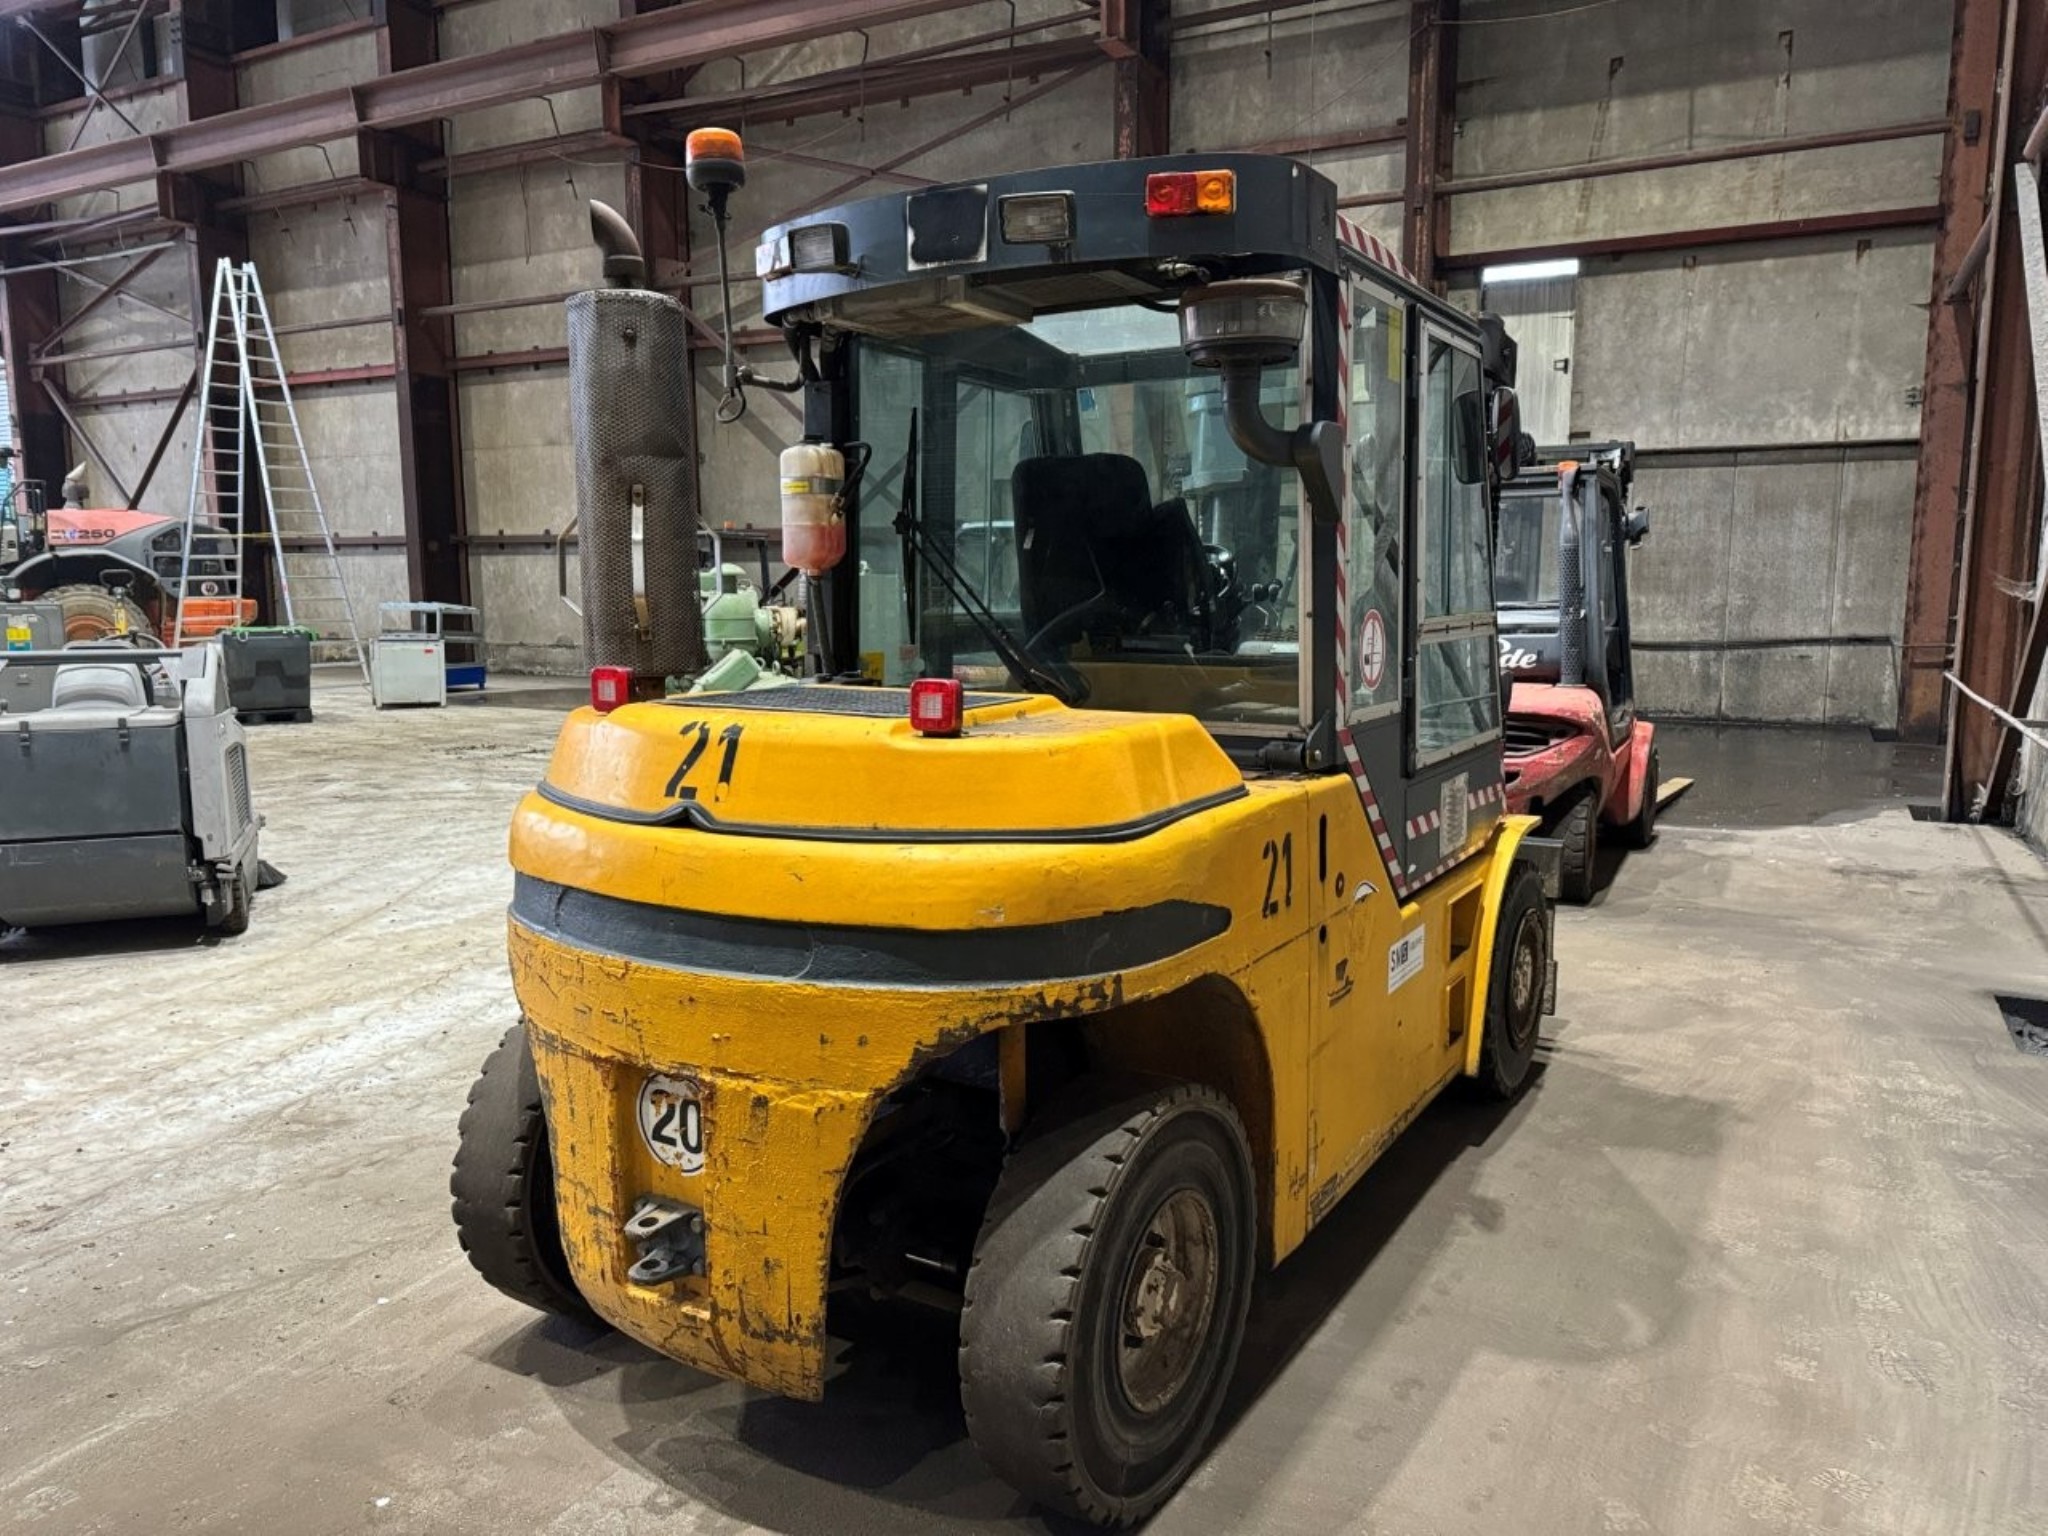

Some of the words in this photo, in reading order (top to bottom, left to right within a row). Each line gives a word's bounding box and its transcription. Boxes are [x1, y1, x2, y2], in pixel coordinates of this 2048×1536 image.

[664, 720, 744, 802] 21
[1262, 831, 1292, 919] 21
[650, 1089, 703, 1154] 20
